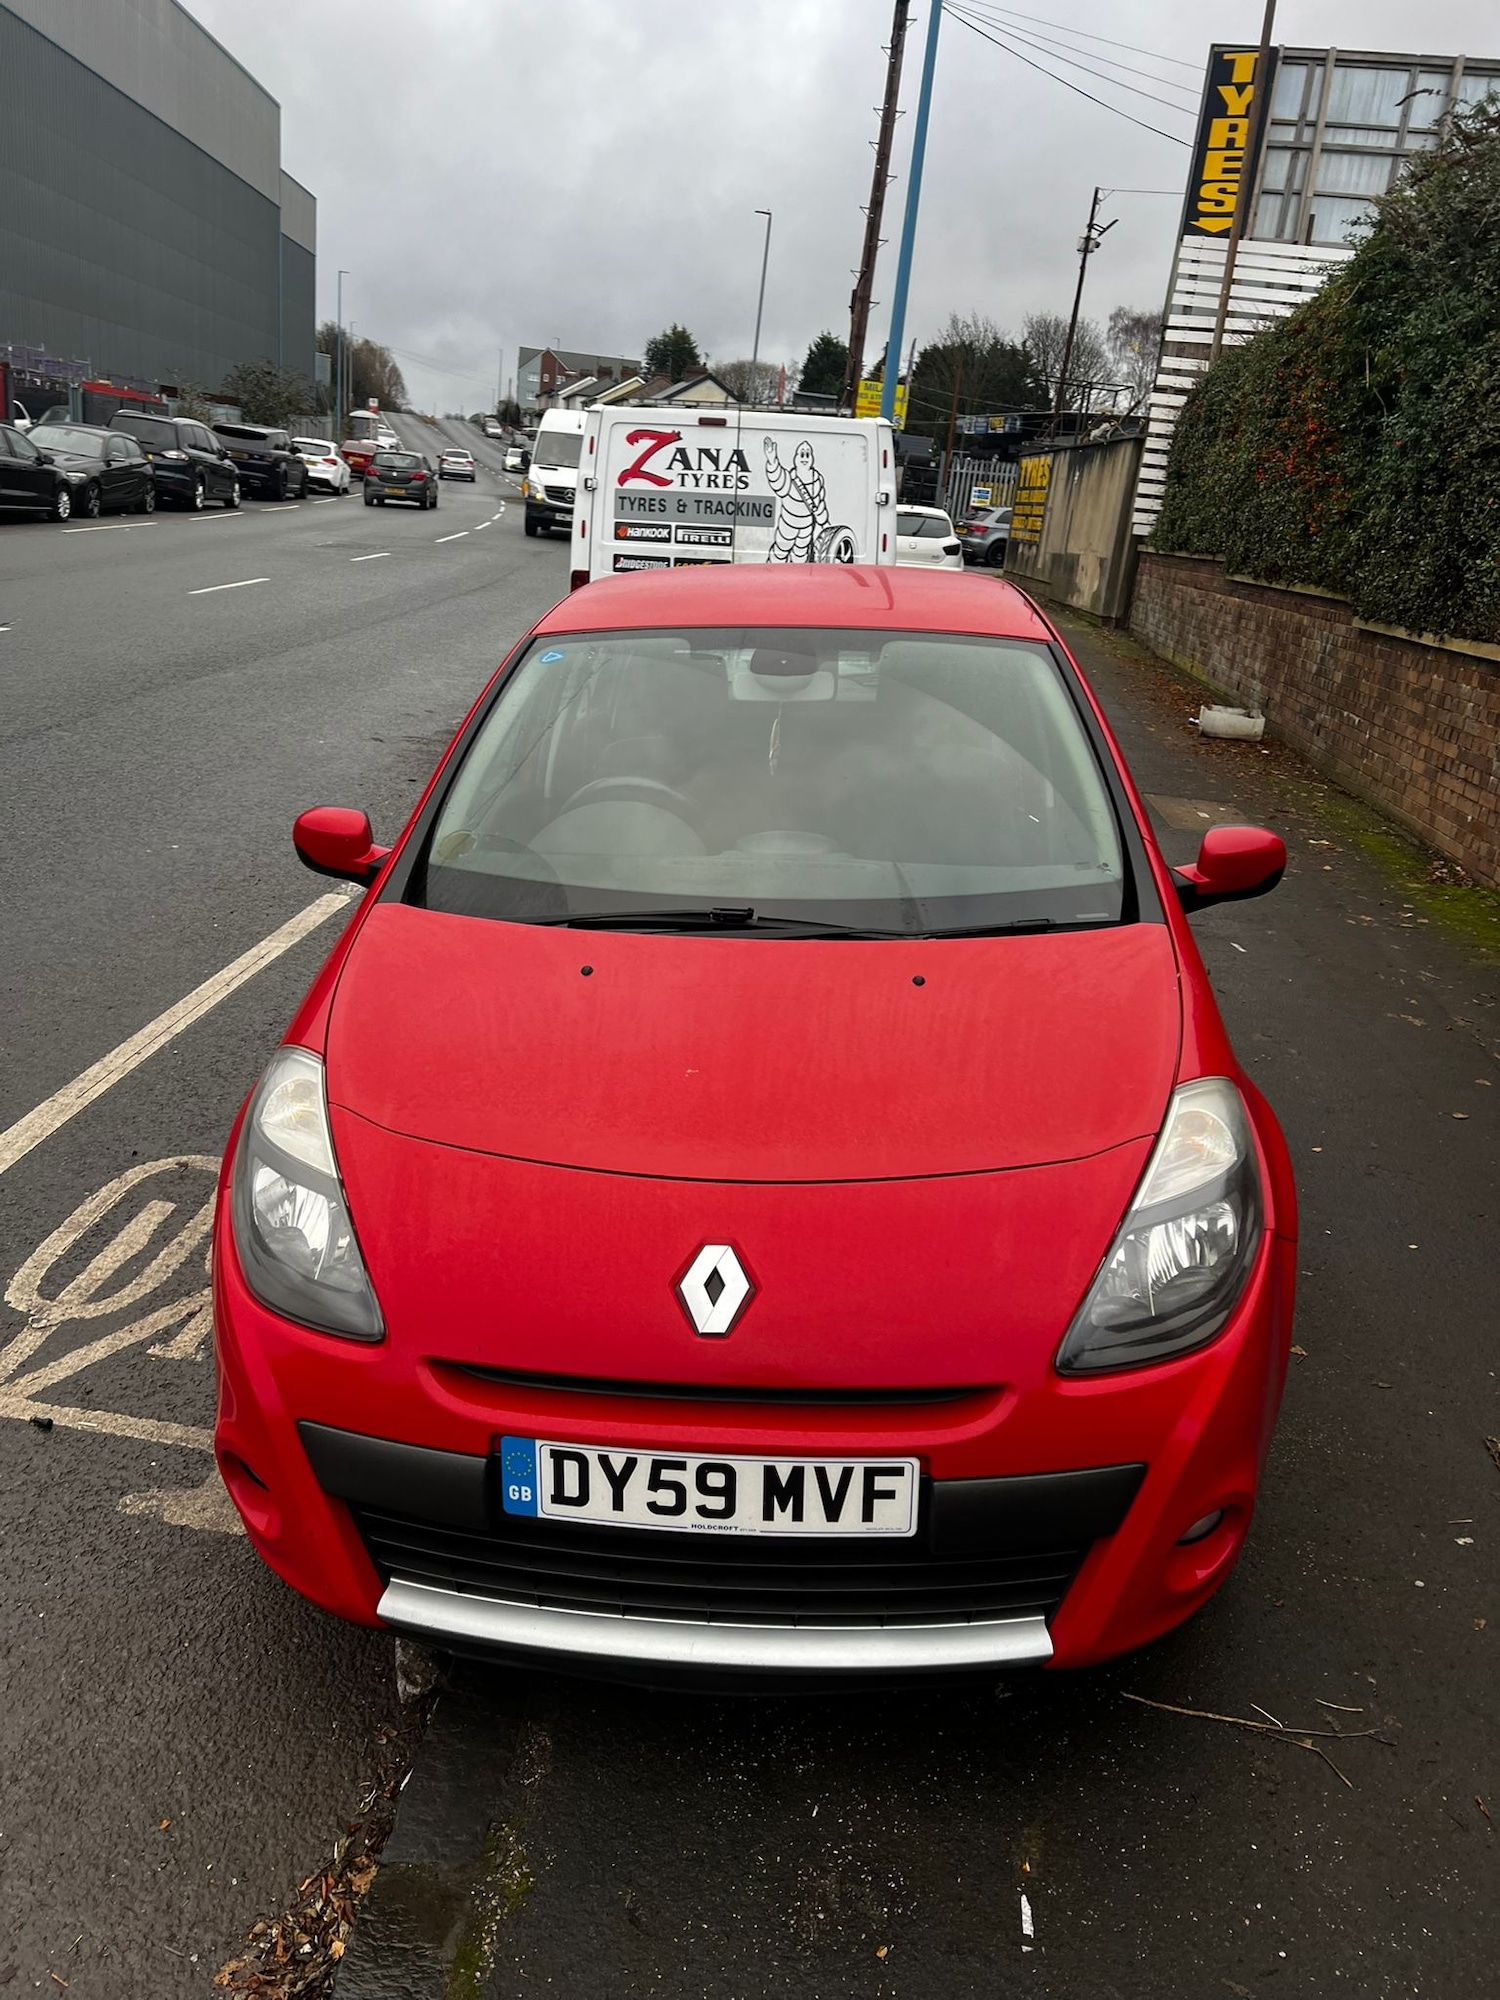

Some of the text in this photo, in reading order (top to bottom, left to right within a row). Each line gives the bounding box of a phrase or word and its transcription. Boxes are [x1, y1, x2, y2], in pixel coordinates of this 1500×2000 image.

[1197, 52, 1259, 213] TYRES
[617, 429, 752, 487] ZANA
[677, 473, 750, 490] TYRES
[1020, 456, 1051, 487] TYRES
[618, 496, 773, 518] TYRES & TRACKING
[676, 528, 732, 544] PIRELLI
[508, 1484, 533, 1502] GB
[550, 1448, 906, 1523] DY59 MVF
[691, 1523, 739, 1532] HOLDCROFT
